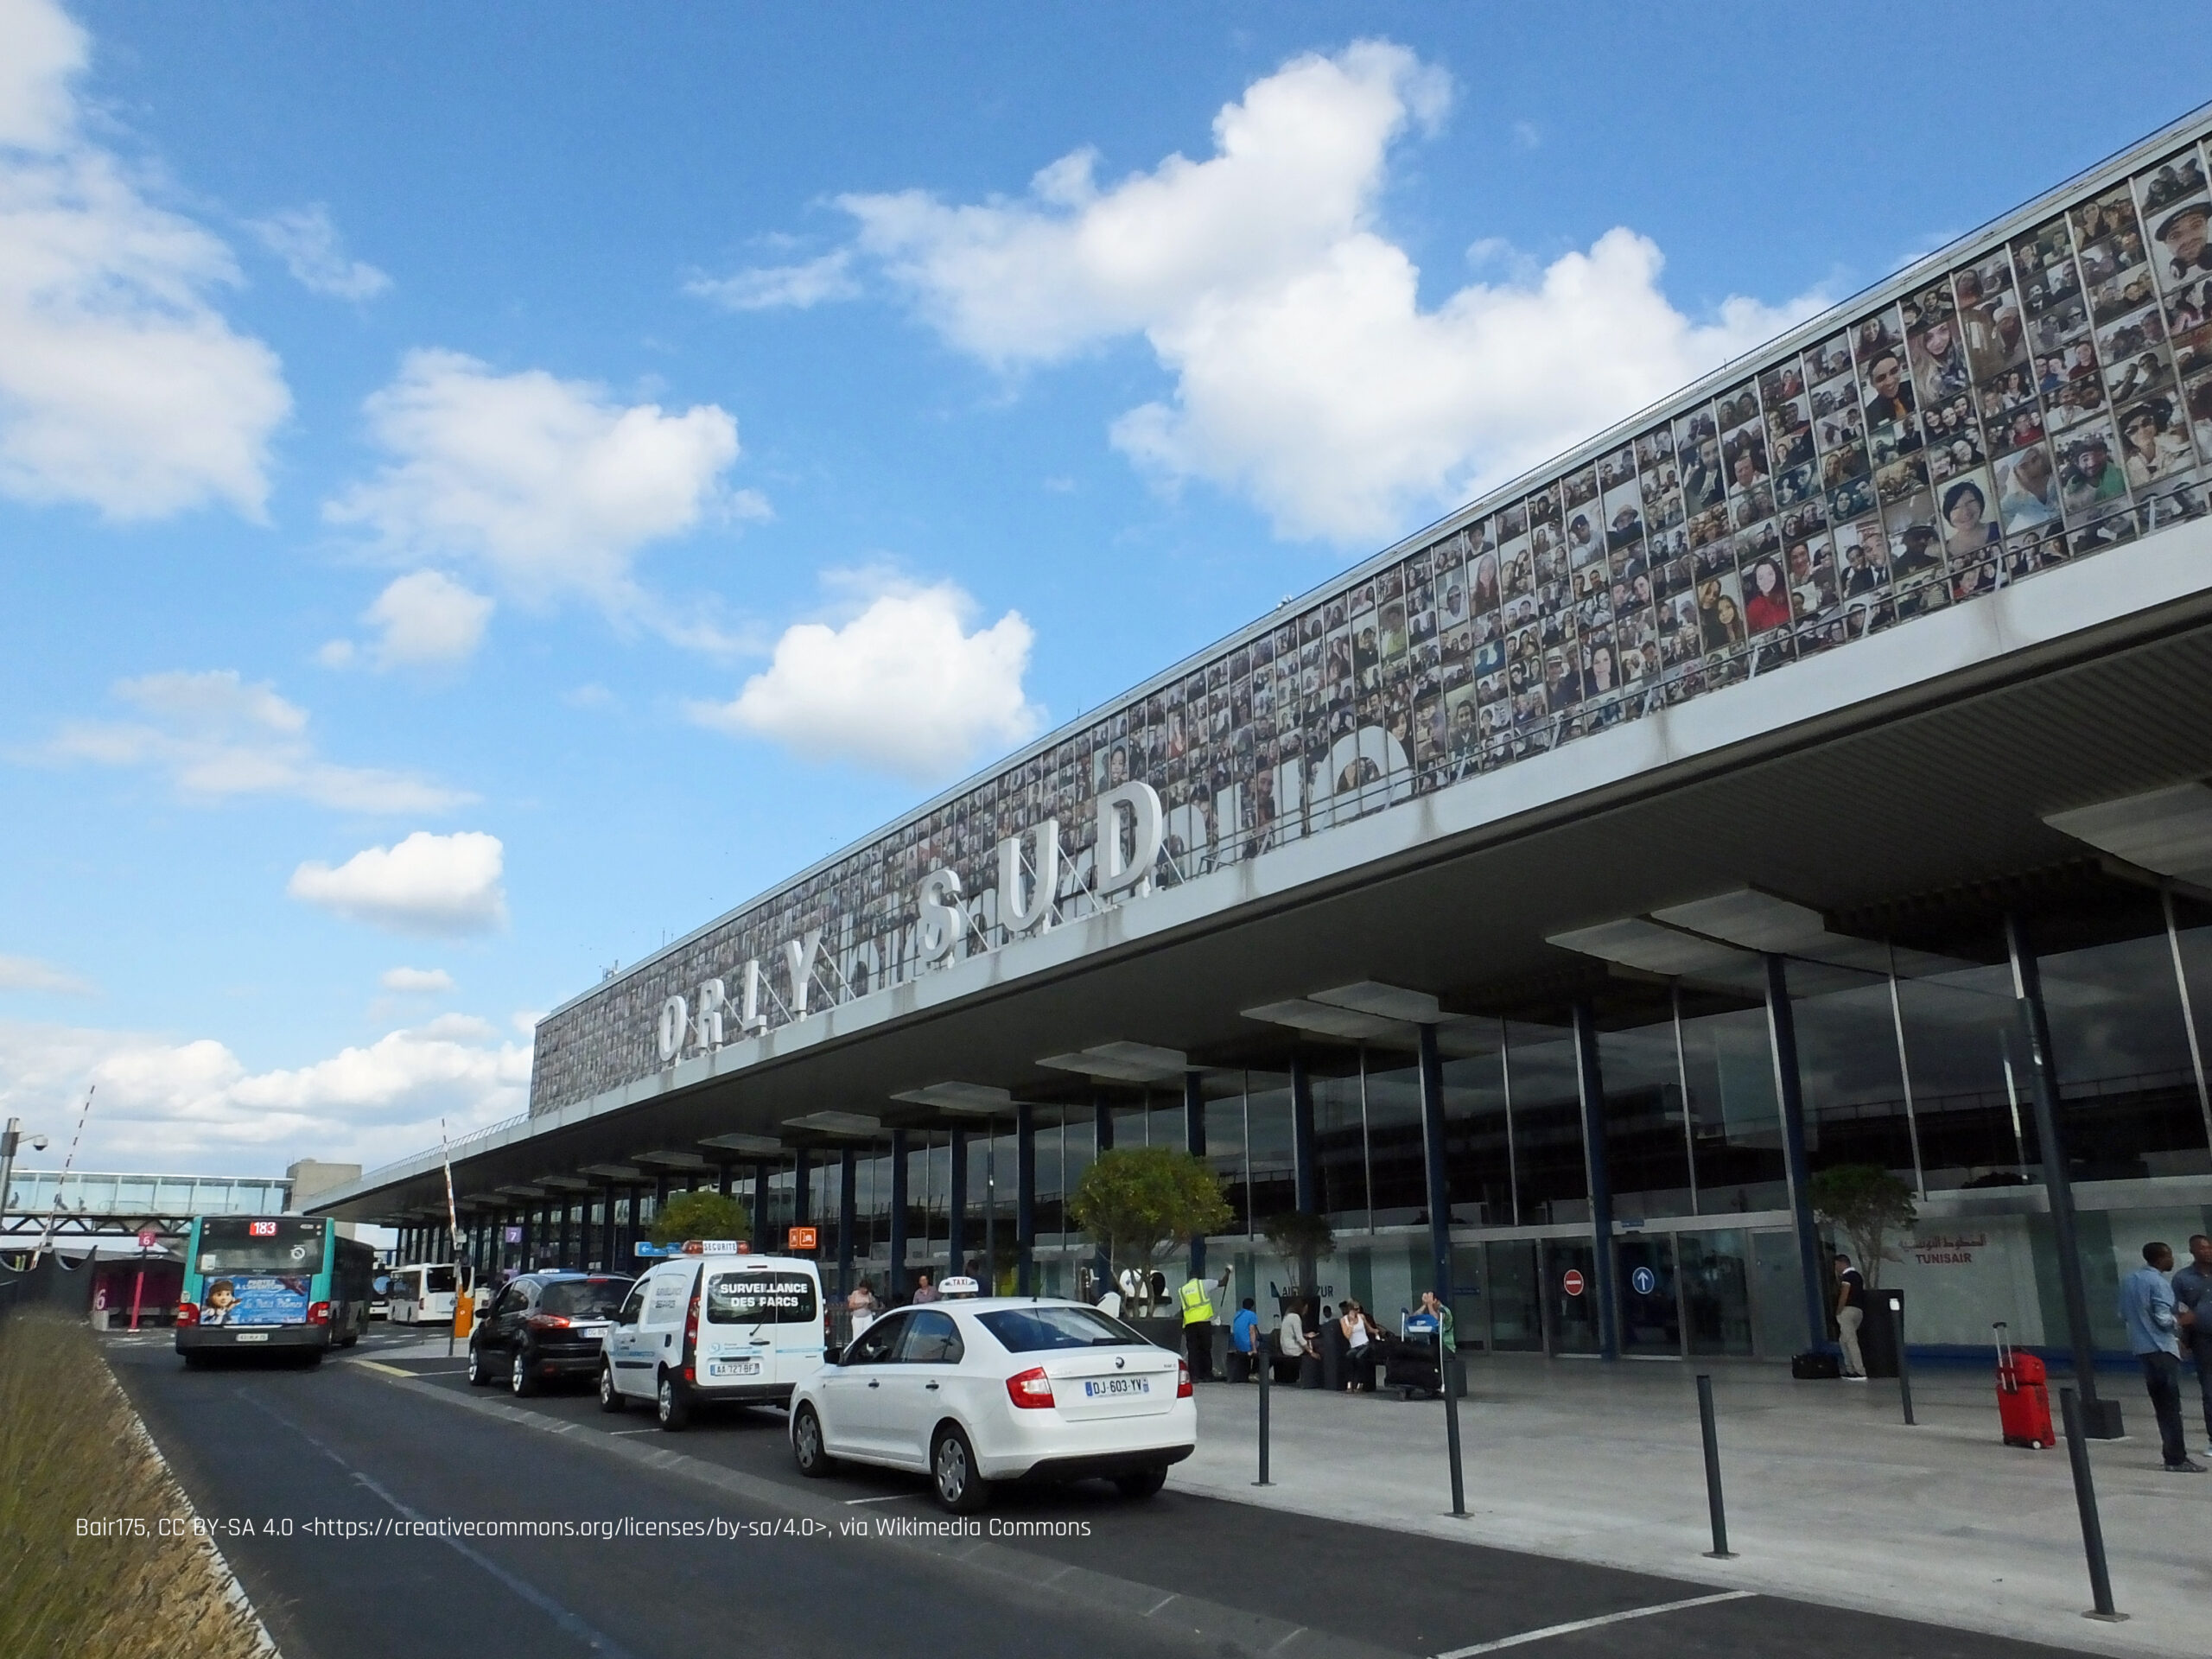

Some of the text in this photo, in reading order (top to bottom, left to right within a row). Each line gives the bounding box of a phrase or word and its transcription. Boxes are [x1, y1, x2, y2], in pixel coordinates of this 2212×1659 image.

[658, 780, 1163, 1062] ORLY SUD
[253, 1222, 276, 1234] 183
[143, 1236, 150, 1245] 6
[510, 1231, 517, 1242] 7
[1915, 1253, 1972, 1264] TUNISAIR
[96, 1288, 106, 1310] 6
[730, 1297, 798, 1307] DES PARCS
